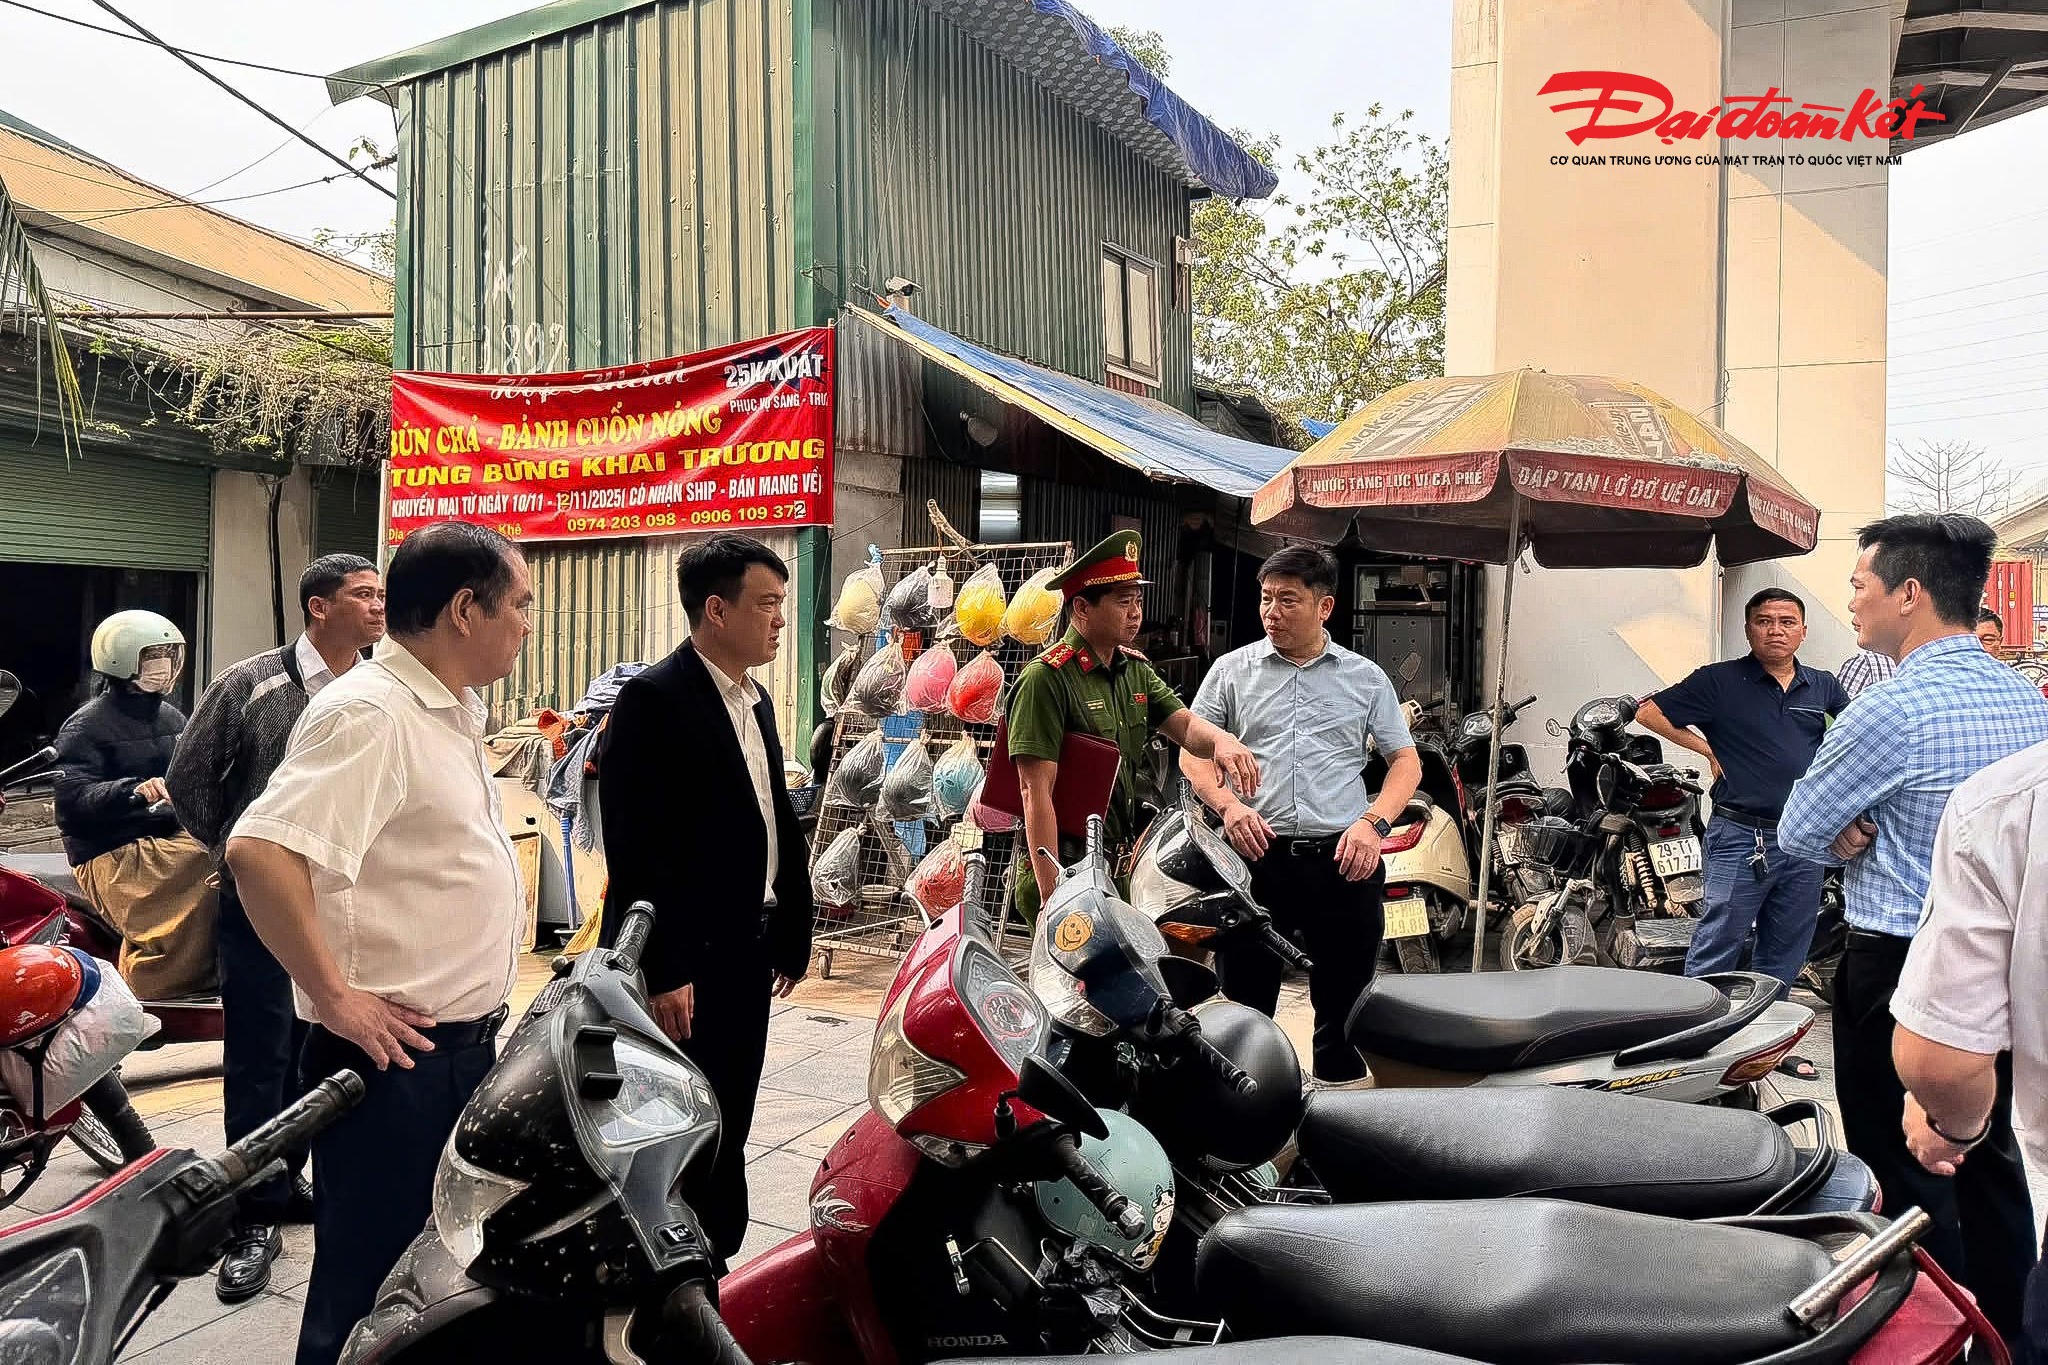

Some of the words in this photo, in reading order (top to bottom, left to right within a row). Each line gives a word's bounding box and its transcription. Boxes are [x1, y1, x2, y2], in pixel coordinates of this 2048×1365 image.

[773, 392, 800, 409] SÁNG
[436, 414, 481, 454] CHẢ
[581, 451, 666, 477] KHAI
[678, 438, 825, 470] TRƯƠNG
[511, 492, 544, 513] 10/11
[686, 480, 717, 502] SHIP
[728, 474, 756, 499] BÁN
[758, 474, 799, 497] MANG
[1561, 471, 1601, 494] TAN
[567, 519, 606, 532] 0974
[611, 515, 641, 530] 203
[645, 512, 677, 528] 098
[690, 508, 732, 525] 0906
[737, 506, 768, 521] 109
[1657, 840, 1692, 858] 29-T1
[927, 1334, 1009, 1347] HONDA
